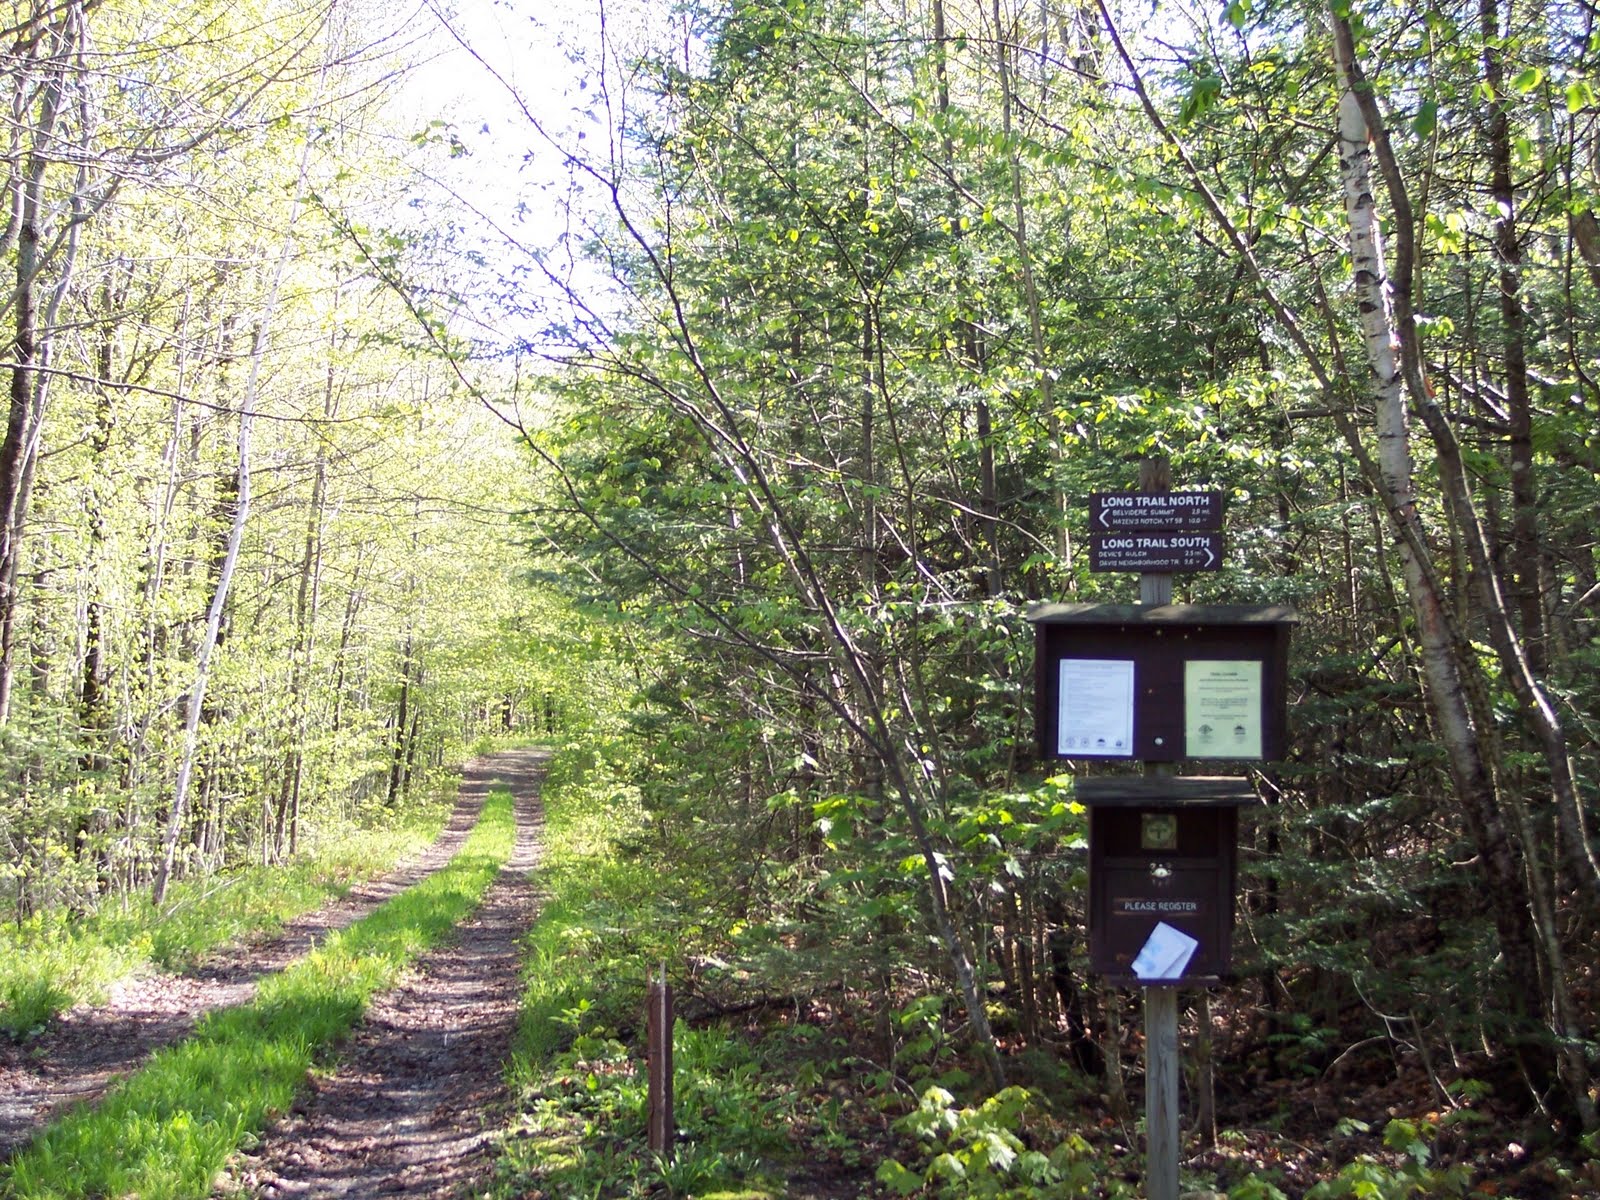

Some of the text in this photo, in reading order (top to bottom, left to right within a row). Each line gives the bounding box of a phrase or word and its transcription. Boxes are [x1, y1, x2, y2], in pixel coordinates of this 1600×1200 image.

[1101, 496, 1209, 507] LONG TRAIL NORTH
[1101, 537, 1210, 549] LONG TRAIL SOUTH
[1124, 902, 1197, 910] PLEASE REGISTER
